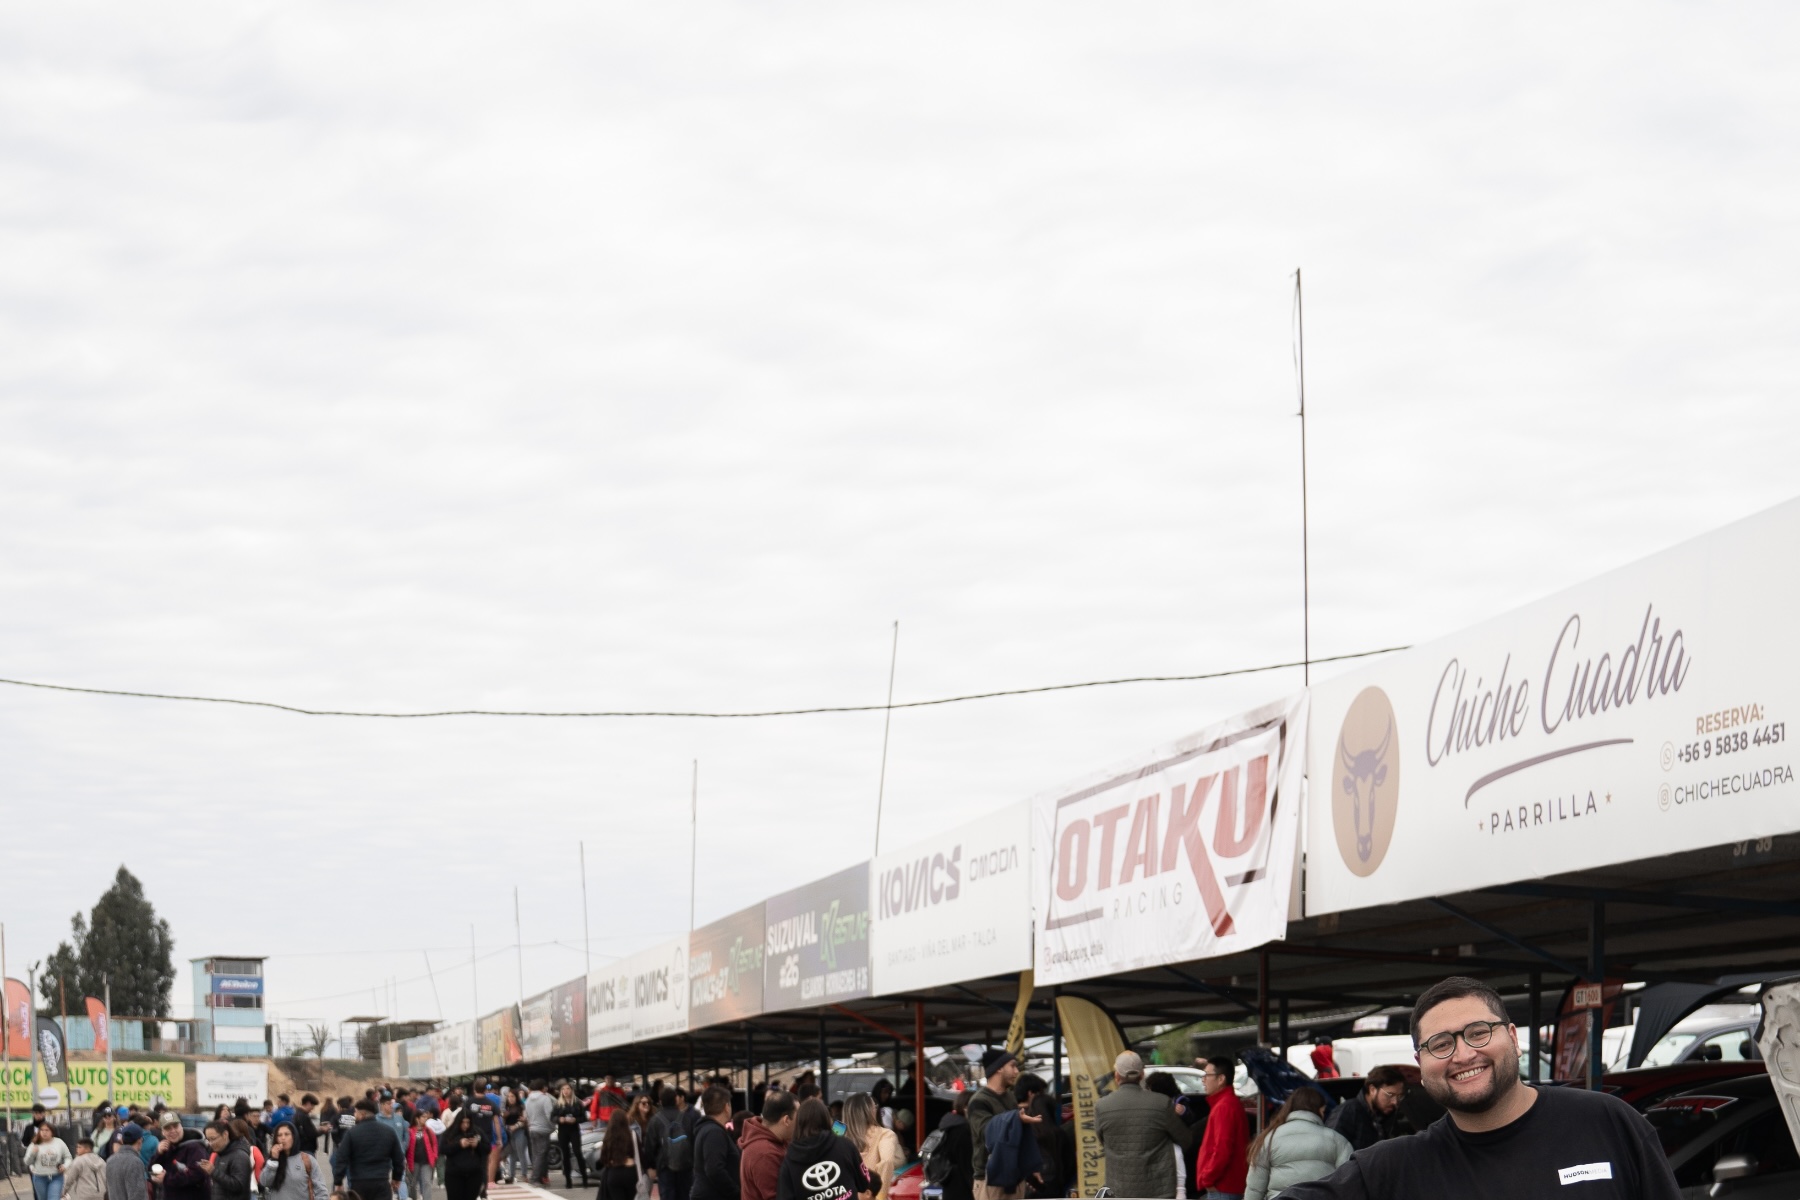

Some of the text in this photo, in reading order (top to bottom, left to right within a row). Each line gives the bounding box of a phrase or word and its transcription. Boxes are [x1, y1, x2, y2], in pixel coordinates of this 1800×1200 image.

[1426, 602, 1692, 767] Chiche Cuadra
[1696, 703, 1765, 735] RESERVA:
[1677, 722, 1786, 763] +56 9 5838 4451
[1674, 764, 1794, 805] CHICHECUADRA
[1490, 790, 1597, 834] PARRILLA
[1056, 754, 1269, 937] OTAKU
[879, 844, 962, 920] KOVACS
[1113, 882, 1182, 920] RACING
[767, 910, 818, 957] SUZUVAL
[68, 1068, 109, 1086] AUTO
[115, 1068, 171, 1086] STOCK
[111, 1090, 173, 1101] EPUESS
